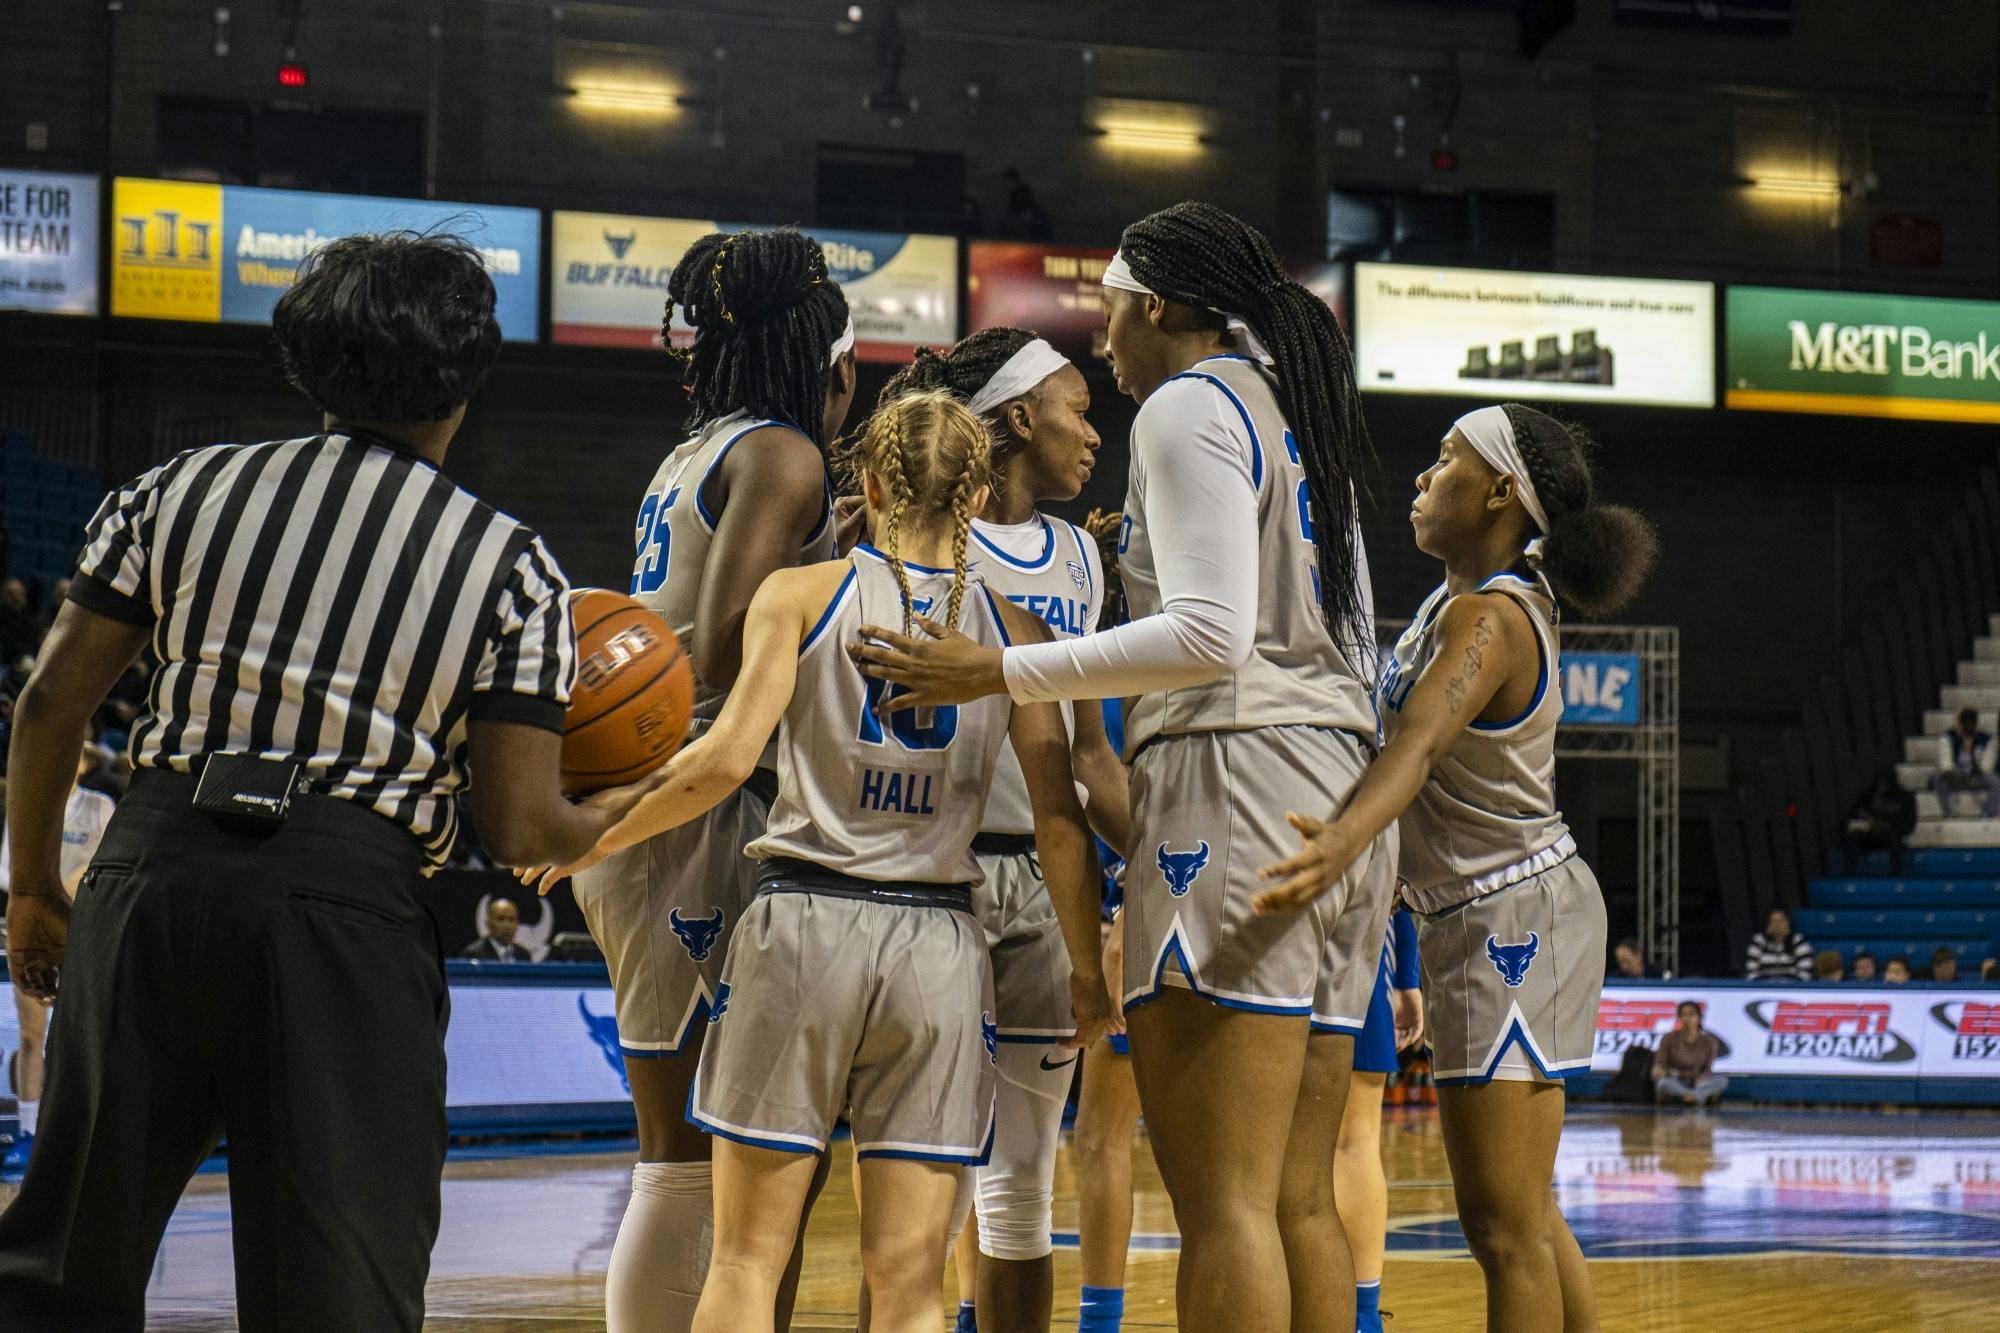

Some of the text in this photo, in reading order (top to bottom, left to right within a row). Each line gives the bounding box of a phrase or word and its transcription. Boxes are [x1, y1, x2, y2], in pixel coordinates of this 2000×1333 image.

[25, 185, 71, 219] FOR
[3, 220, 70, 256] TEAM
[1377, 280, 1401, 297] The
[1407, 283, 1472, 301] difference
[1475, 286, 1530, 304] between
[1534, 291, 1604, 309] healthcare
[1610, 296, 1635, 312] and
[1787, 319, 2000, 381] M&T Bank
[629, 486, 683, 598] 25
[859, 768, 935, 815] HALL
[1771, 1001, 1891, 1034] ESPN
[1766, 1034, 1884, 1059] 1520AM
